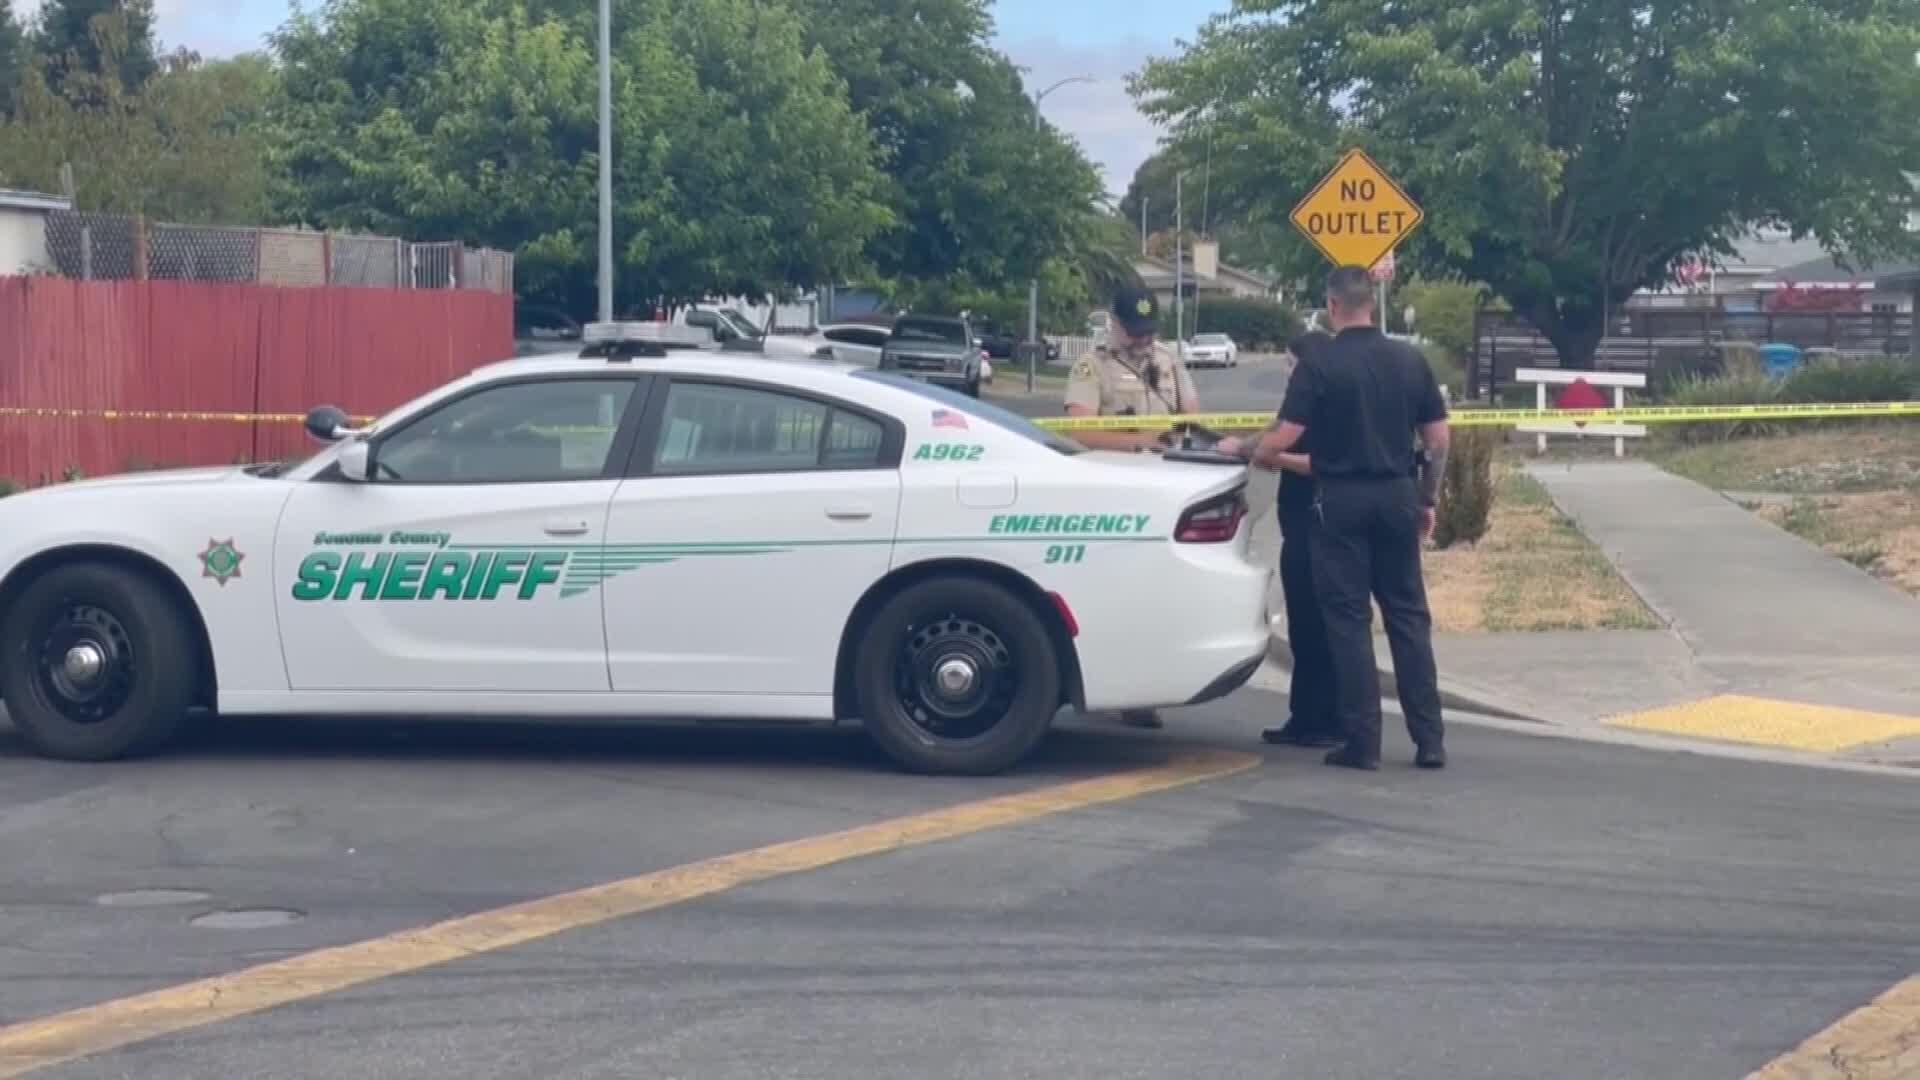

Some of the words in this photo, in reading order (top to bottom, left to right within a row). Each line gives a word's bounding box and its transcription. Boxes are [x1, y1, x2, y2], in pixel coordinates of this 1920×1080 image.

[1340, 179, 1376, 202] NO
[1308, 211, 1407, 235] OUTLET
[913, 443, 985, 461] A962
[988, 515, 1150, 533] EMERGENCY
[389, 530, 452, 549] County
[1044, 544, 1086, 564] 911
[291, 550, 569, 601] SHERIFF
